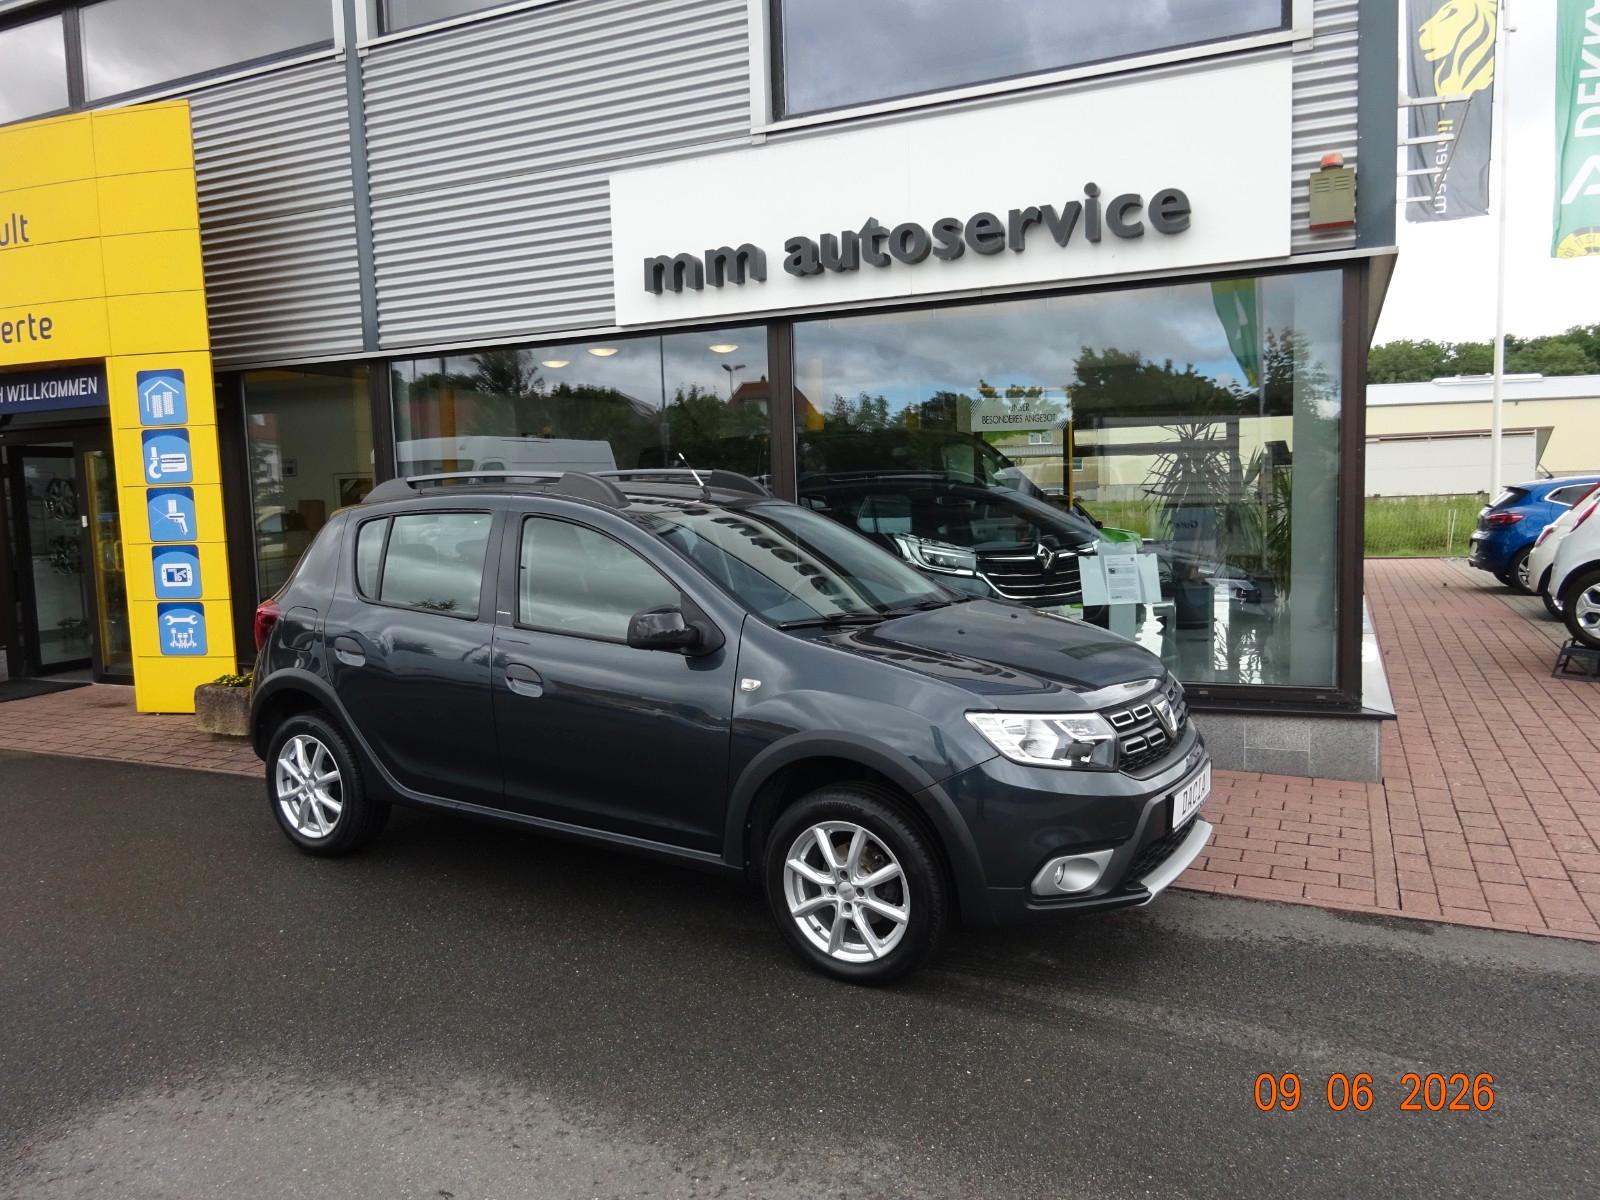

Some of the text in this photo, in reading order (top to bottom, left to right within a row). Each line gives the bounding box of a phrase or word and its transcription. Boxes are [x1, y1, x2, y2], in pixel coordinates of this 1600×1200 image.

[643, 181, 1192, 295] mm autoservice
[7, 376, 99, 402] WILLKOMMEN
[981, 414, 1023, 425] BESONDERES
